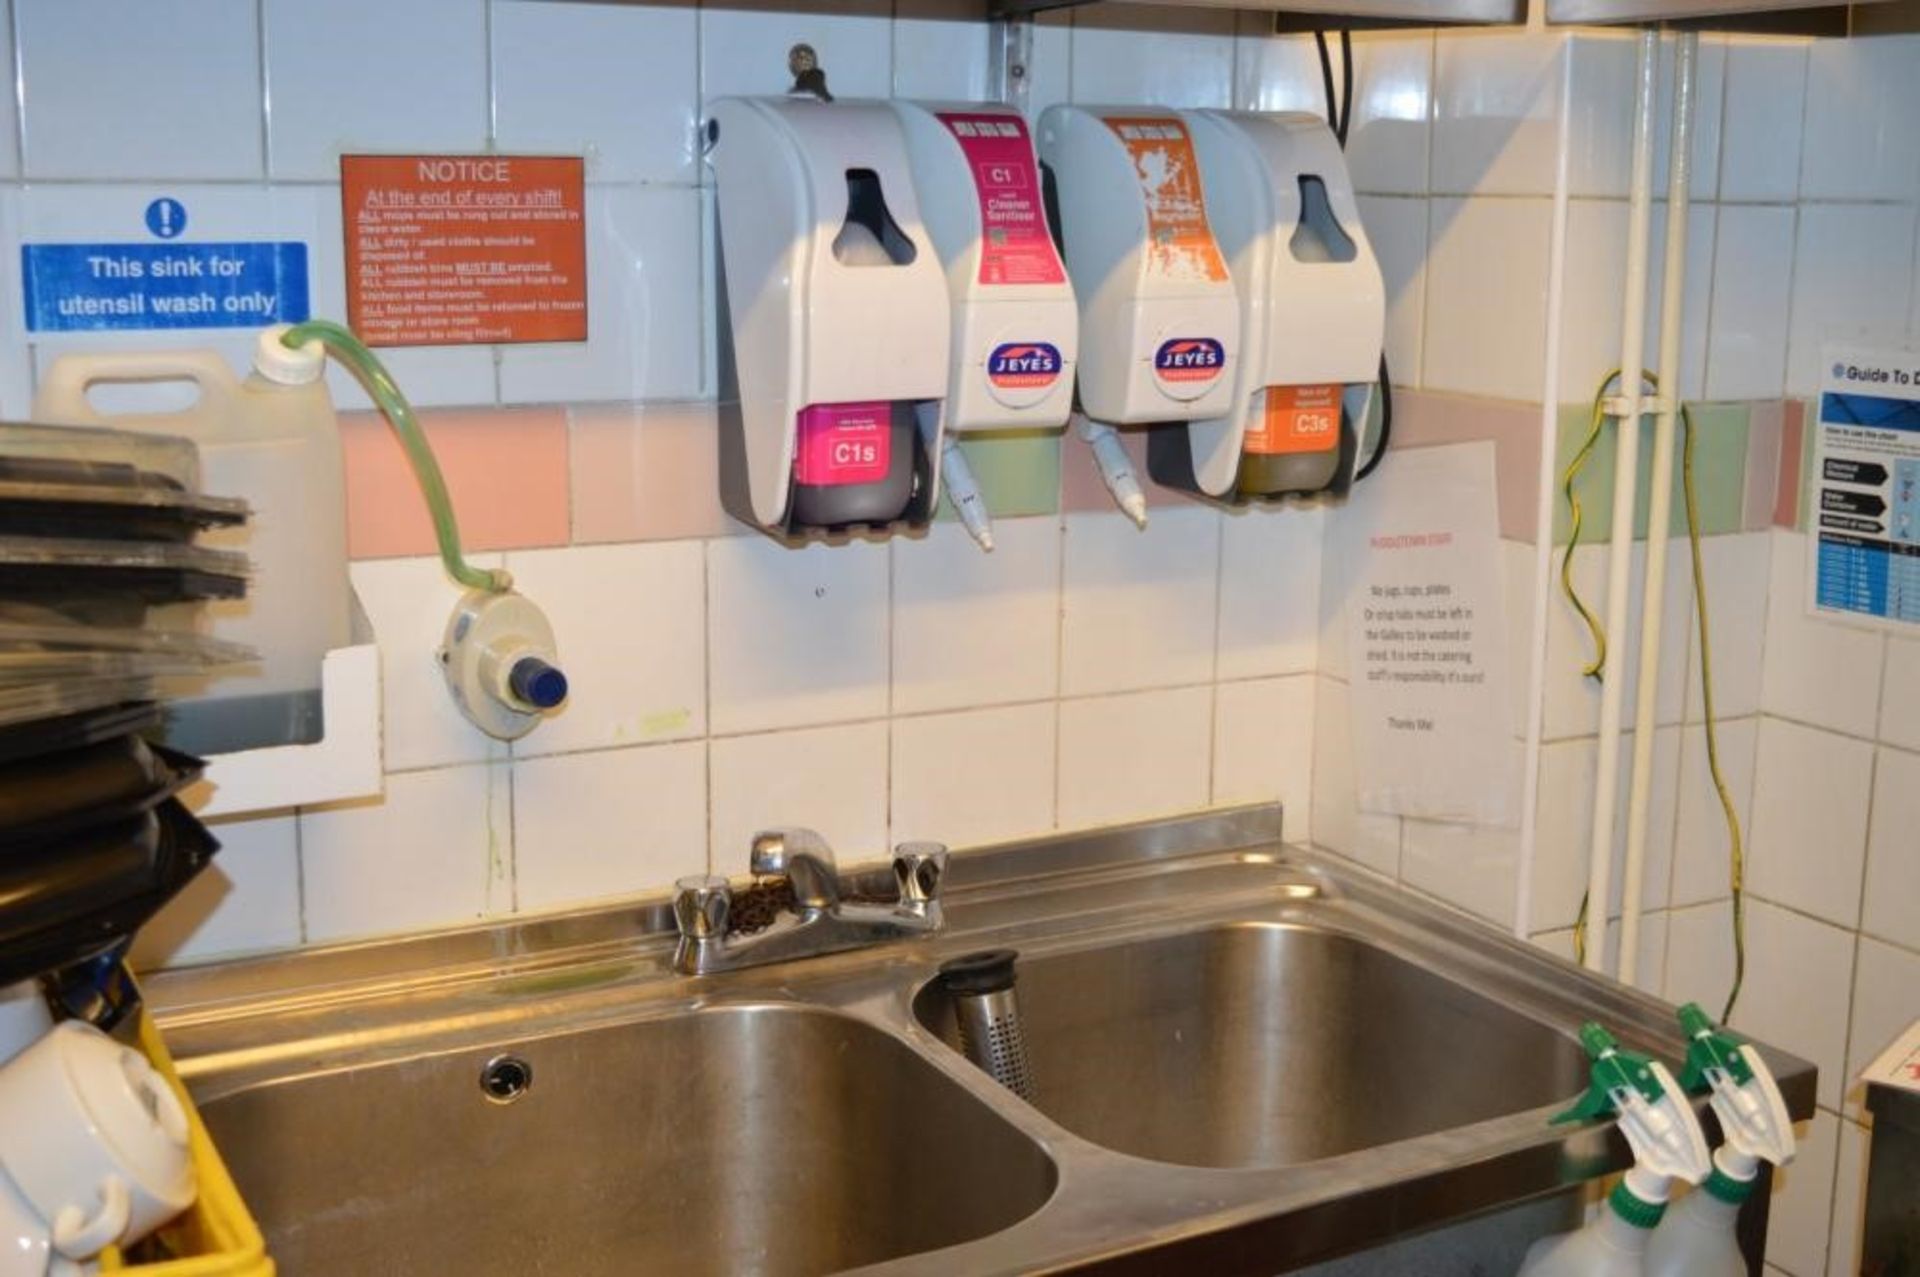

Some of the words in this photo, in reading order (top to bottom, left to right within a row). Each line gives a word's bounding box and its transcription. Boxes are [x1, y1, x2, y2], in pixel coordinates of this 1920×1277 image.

[419, 161, 511, 182] NOTICE
[991, 168, 1012, 183] C1
[365, 189, 384, 207] At
[388, 189, 414, 207] the
[419, 189, 450, 207] end
[456, 189, 471, 207] of
[475, 191, 520, 208] every
[525, 189, 562, 207] shift!
[988, 199, 1030, 210] Cleaner
[358, 210, 381, 223] ALL
[416, 211, 444, 220] must
[446, 210, 460, 220] be
[491, 211, 508, 220] out
[511, 211, 530, 220] and
[533, 210, 567, 220] stored
[987, 210, 1035, 222] Sanitiser
[359, 237, 382, 251] ALL
[419, 238, 445, 247] used
[484, 237, 520, 247] should
[522, 236, 536, 246] be
[88, 257, 144, 278] This
[151, 255, 203, 278] sink
[210, 255, 245, 277] for
[360, 263, 383, 277] ALL
[456, 262, 487, 275] MUST
[490, 262, 507, 275] BE
[361, 277, 382, 289] ALL
[430, 277, 458, 287] must
[460, 276, 473, 287] be
[525, 275, 549, 286] from
[551, 275, 568, 285] the
[404, 291, 426, 300] and
[58, 293, 144, 316] utensil
[147, 292, 216, 313] wash
[223, 292, 277, 316] only
[362, 304, 384, 317] ALL
[387, 304, 412, 314] food
[446, 303, 475, 313] must
[477, 302, 490, 312] be
[997, 357, 1053, 372] JEYES
[1163, 352, 1217, 366] JEYES
[1846, 365, 1889, 383] Guide
[1893, 369, 1910, 385] To
[1296, 414, 1329, 433] C3s
[835, 442, 876, 463] C1s
[1371, 585, 1383, 597] No
[1364, 608, 1373, 621] Or
[1415, 608, 1435, 620] must
[1437, 608, 1447, 619] be
[1450, 607, 1464, 620] left
[1366, 629, 1378, 641] the
[1380, 629, 1404, 643] Galley
[1406, 629, 1415, 640] to
[1417, 629, 1427, 640] be
[1429, 629, 1460, 641] washed
[1407, 650, 1420, 661] not
[1422, 650, 1436, 661] the
[1437, 650, 1472, 664] catering
[1393, 670, 1446, 684] responsibility
[1388, 716, 1415, 731] Thanks
